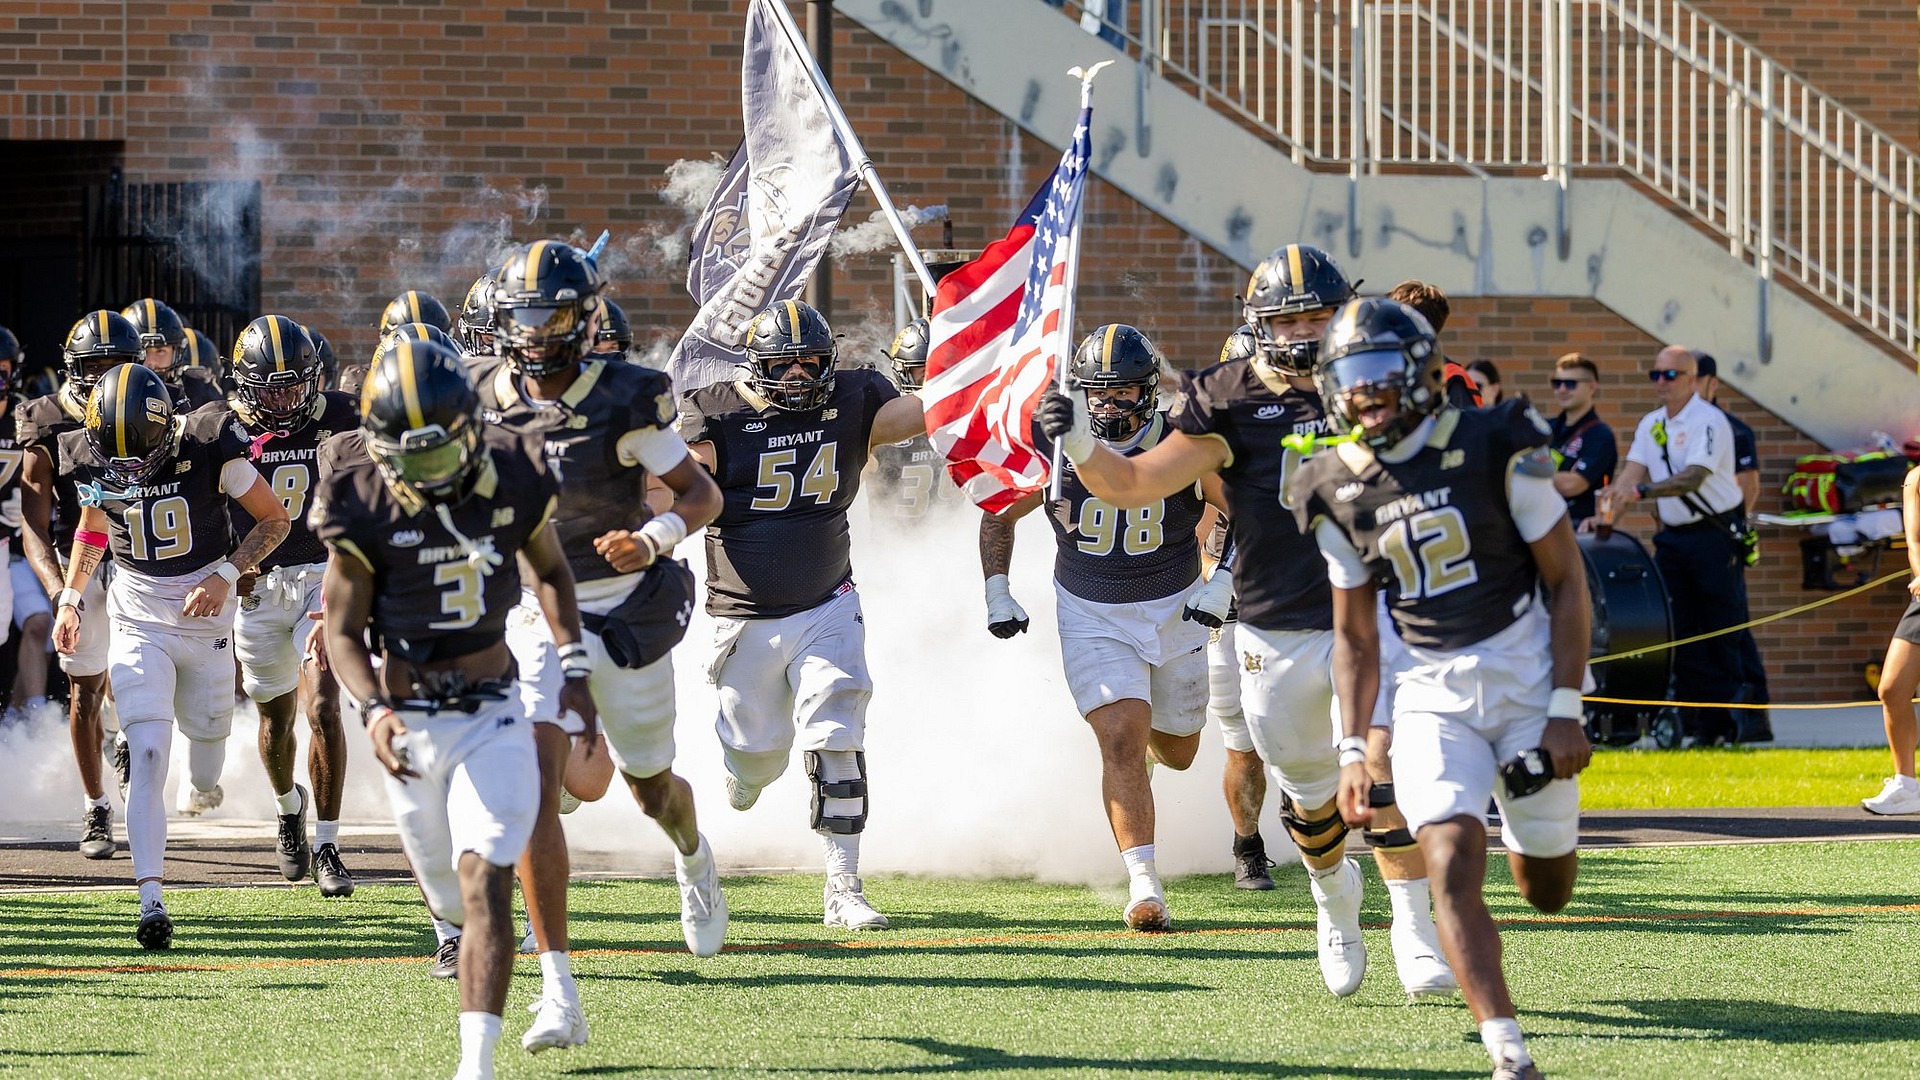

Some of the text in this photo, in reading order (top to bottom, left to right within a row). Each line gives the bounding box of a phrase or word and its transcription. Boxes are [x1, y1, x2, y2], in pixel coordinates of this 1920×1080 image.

[745, 422, 763, 430] CAA
[768, 430, 824, 449] BRYANT
[1293, 417, 1328, 435] BRY
[261, 449, 315, 464] BRYANT
[750, 441, 839, 511] 54
[125, 481, 180, 498] RYANT
[272, 464, 310, 521] 8
[1375, 486, 1451, 526] BRYANT
[123, 495, 193, 561] 19
[1077, 497, 1165, 556] 98
[1378, 505, 1478, 599] 12
[428, 559, 487, 630] 3
